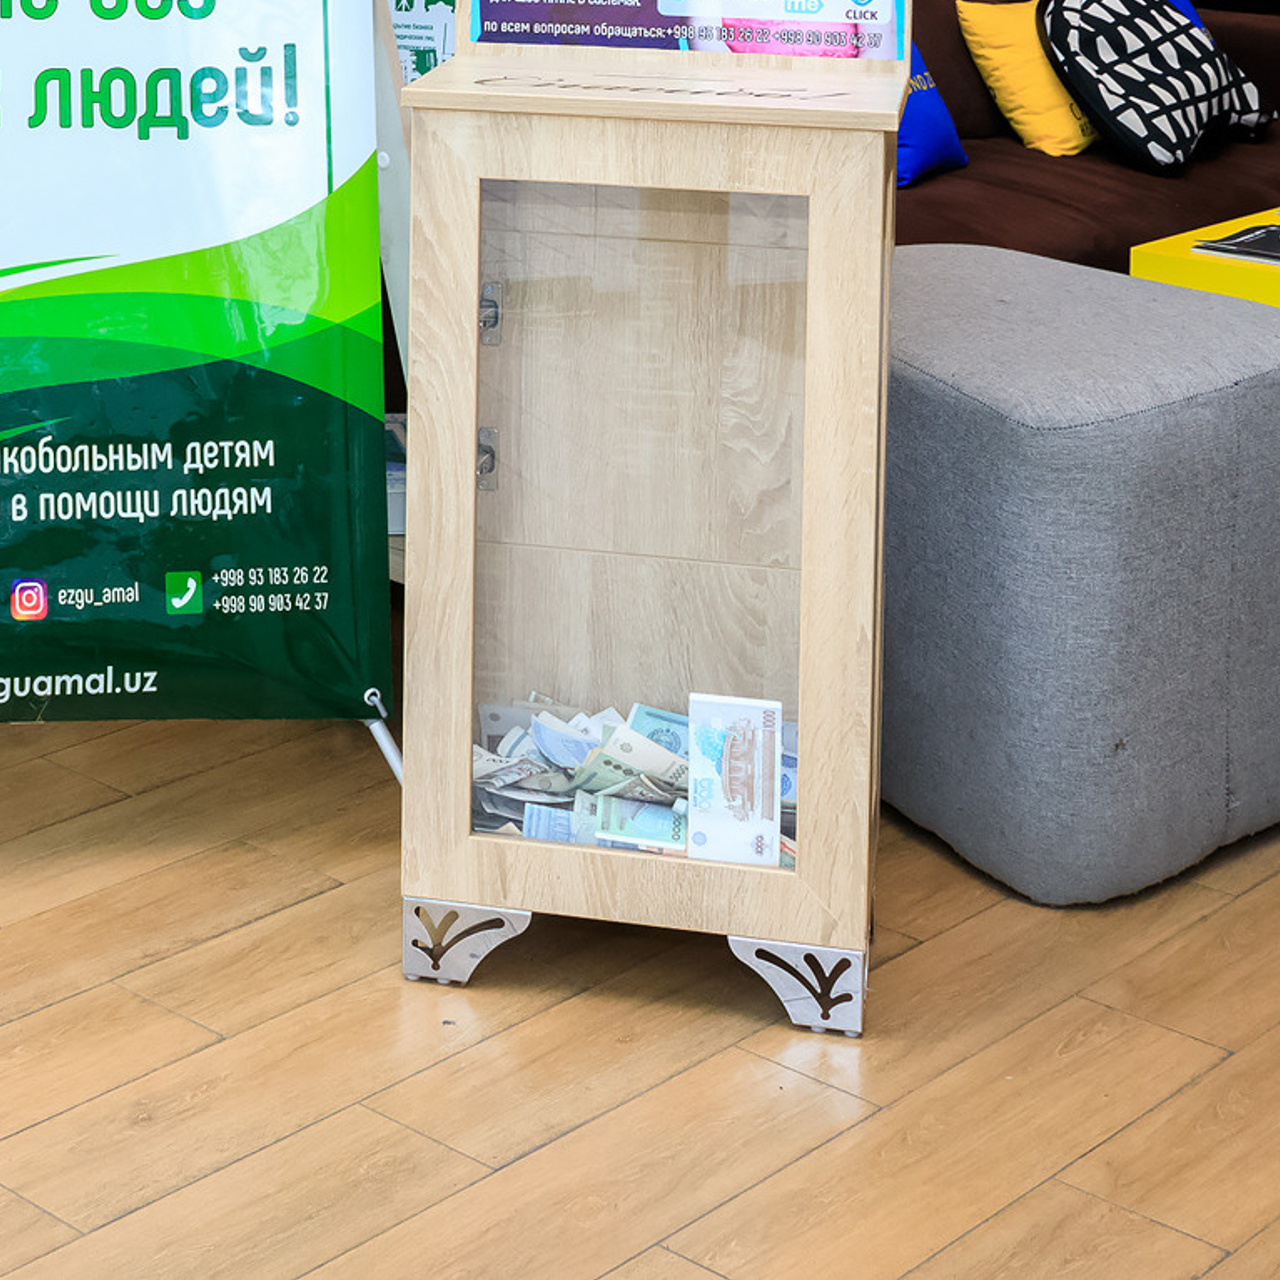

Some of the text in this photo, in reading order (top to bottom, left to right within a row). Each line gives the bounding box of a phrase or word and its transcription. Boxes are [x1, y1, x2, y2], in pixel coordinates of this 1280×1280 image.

[484, 21, 498, 33] по
[501, 21, 531, 33] всем
[533, 22, 591, 37] вопросам
[738, 28, 753, 42] 26
[756, 29, 770, 43] 22
[806, 31, 821, 45] 90
[845, 9, 878, 21] CLICK
[28, 43, 300, 140] людей!
[184, 439, 276, 476] детям
[12, 498, 29, 521] в
[39, 491, 160, 526] помощи
[170, 484, 273, 521] людям
[57, 582, 140, 611] ezgu_amal
[212, 569, 245, 587] +998
[249, 568, 265, 586] 93
[268, 567, 290, 586] 183
[293, 566, 308, 585] 26
[311, 565, 329, 584] 22
[213, 593, 330, 613] +998 90 903 42 37
